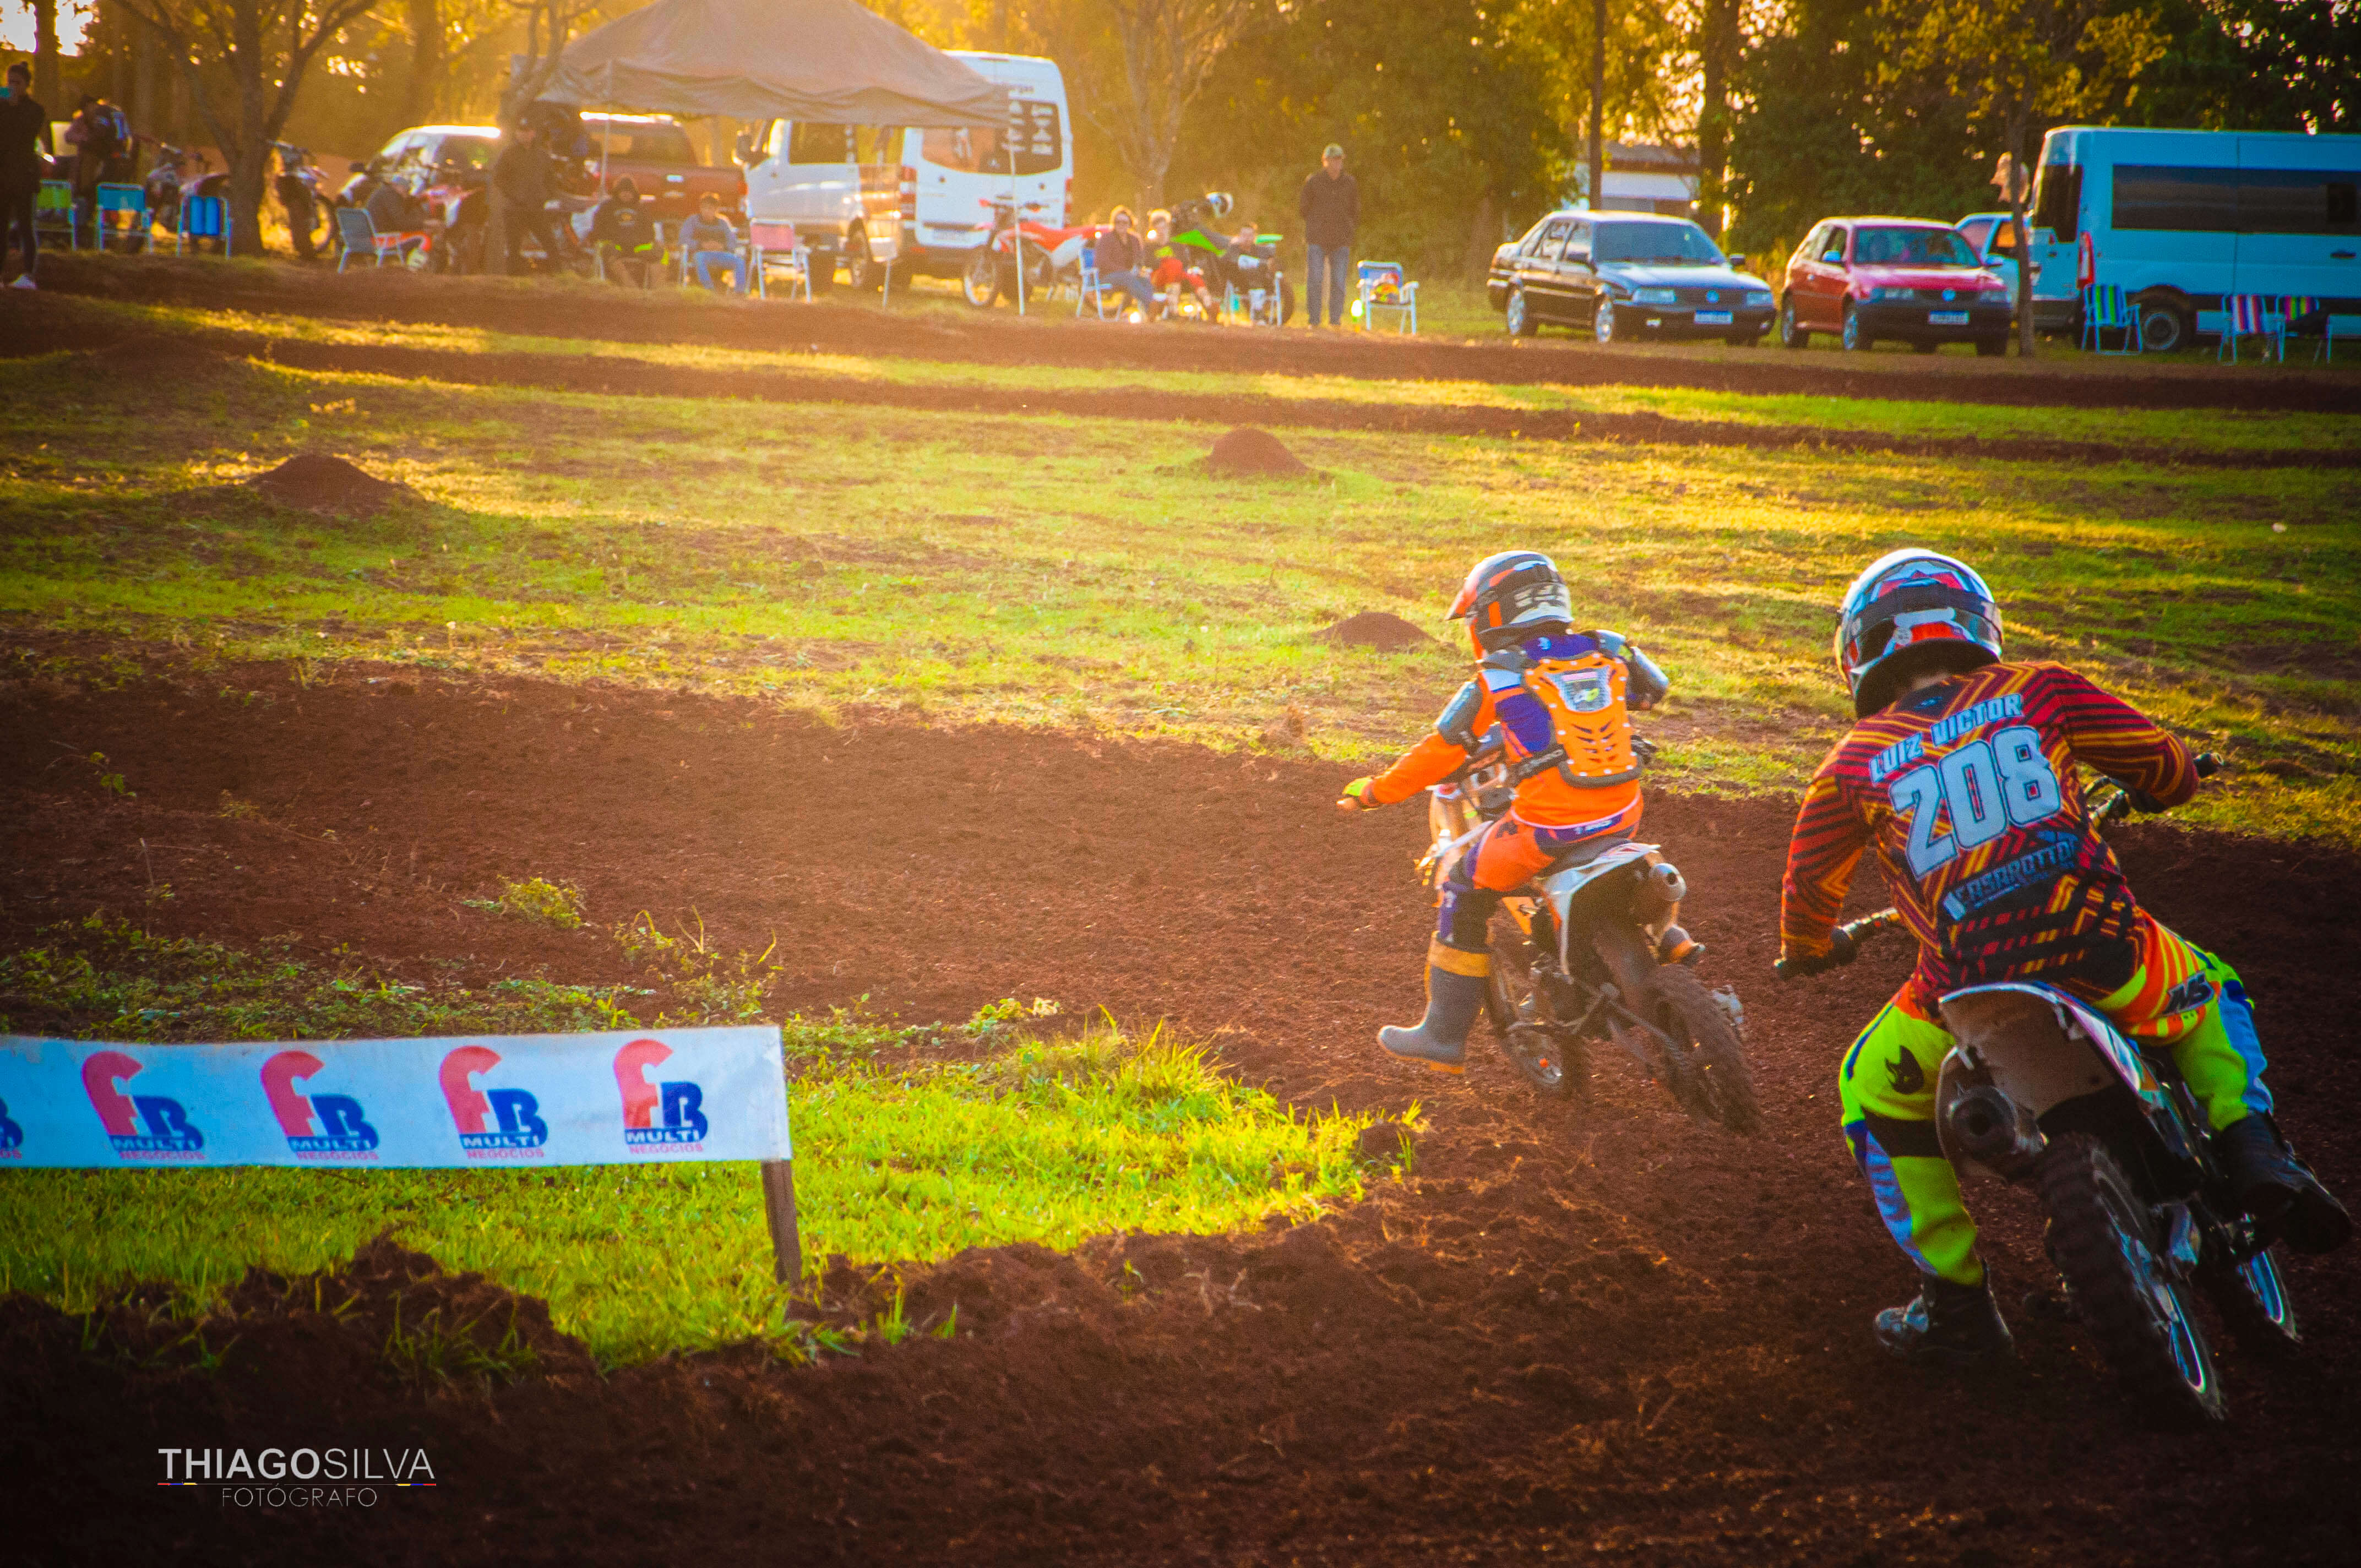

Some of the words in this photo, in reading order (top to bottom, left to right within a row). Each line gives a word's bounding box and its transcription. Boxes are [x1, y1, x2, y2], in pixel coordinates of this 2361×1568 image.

[1869, 732, 1924, 786] LUIZ
[1930, 693, 2025, 747] VICTOR
[1889, 725, 2062, 881] 208
[463, 1135, 540, 1147] MULTI
[626, 1129, 700, 1143] MULTI
[290, 1139, 371, 1151] MULTI
